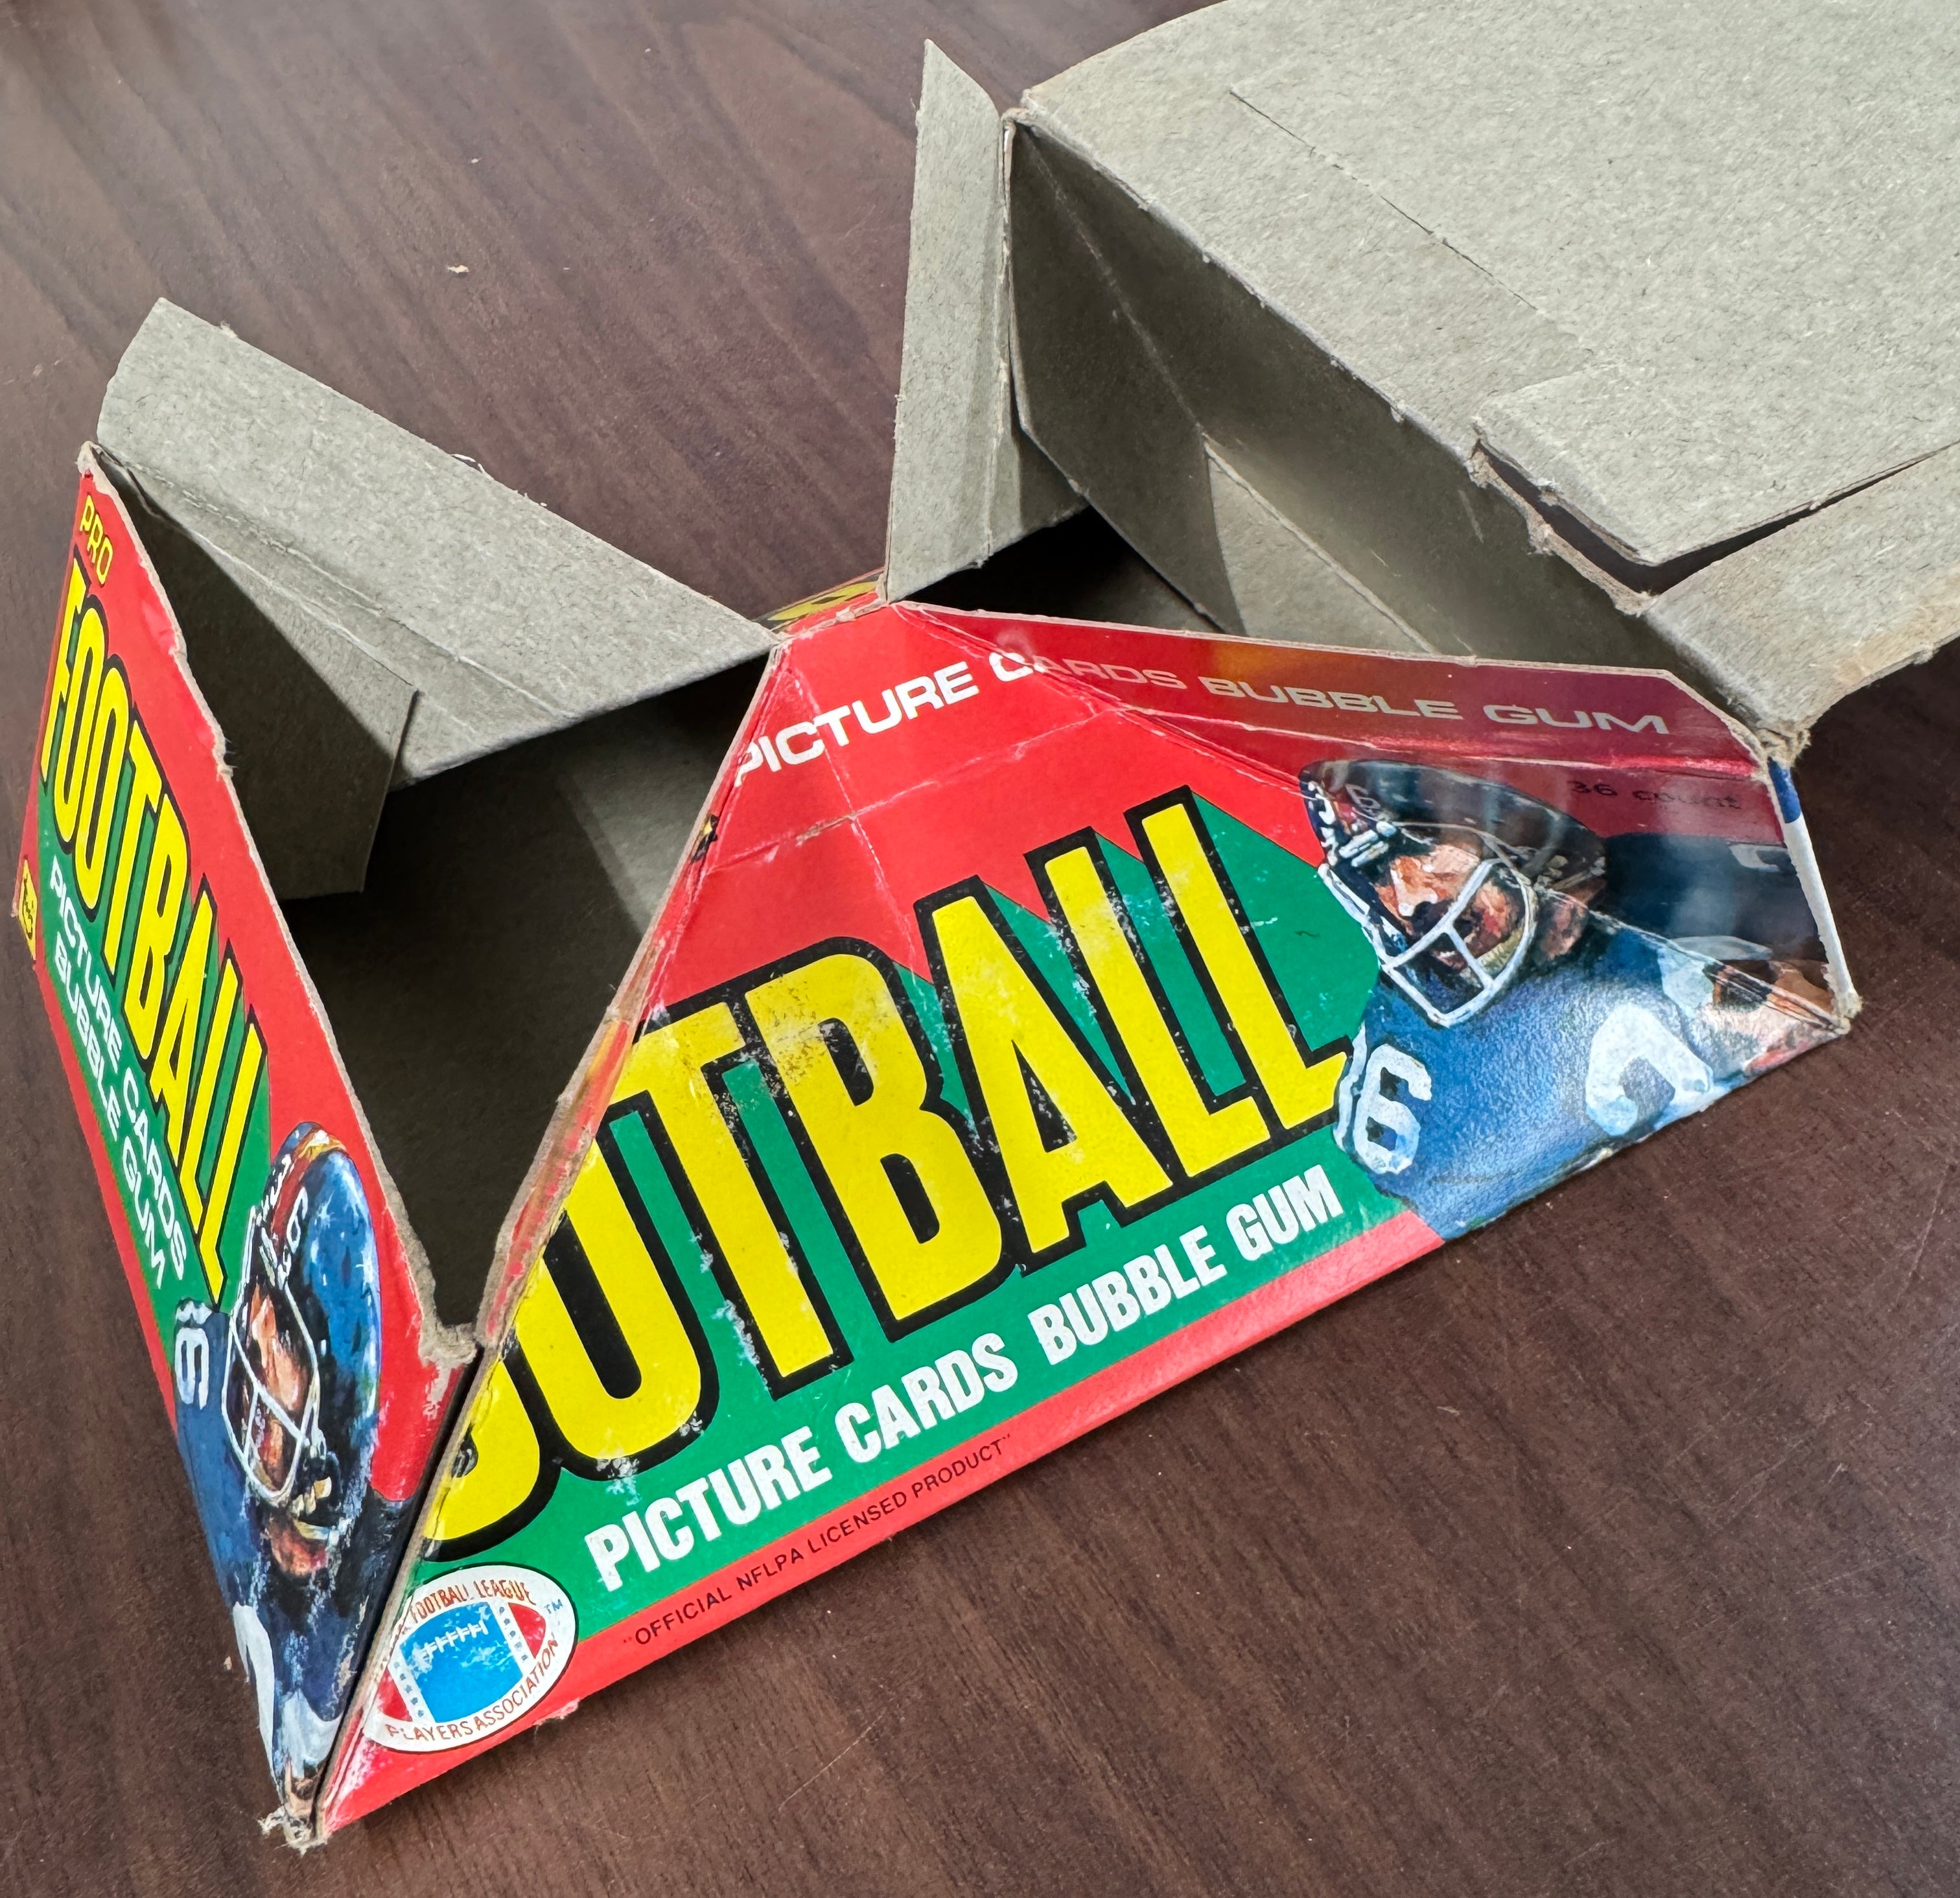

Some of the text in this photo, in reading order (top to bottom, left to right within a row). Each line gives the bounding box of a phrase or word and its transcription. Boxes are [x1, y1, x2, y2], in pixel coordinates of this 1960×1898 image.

[78, 492, 113, 586] PRO
[734, 651, 1670, 788] PICTURE CARDS BUBBLE GUM
[1567, 780, 1618, 797] 36
[39, 552, 266, 1302] FOOTBALL
[49, 854, 188, 1282] PICTURE CARDS
[54, 930, 167, 1291] BUBBLE GUM
[584, 1164, 1344, 1593] PICTURE CARDS BUBBLE GUM
[472, 1578, 537, 1606] LEAGUE
[736, 1548, 805, 1593] NFLPA
[808, 1489, 908, 1554] LICENSED
[384, 1720, 474, 1742] PLAYERS
[475, 1632, 559, 1732] ASSOCIATION
